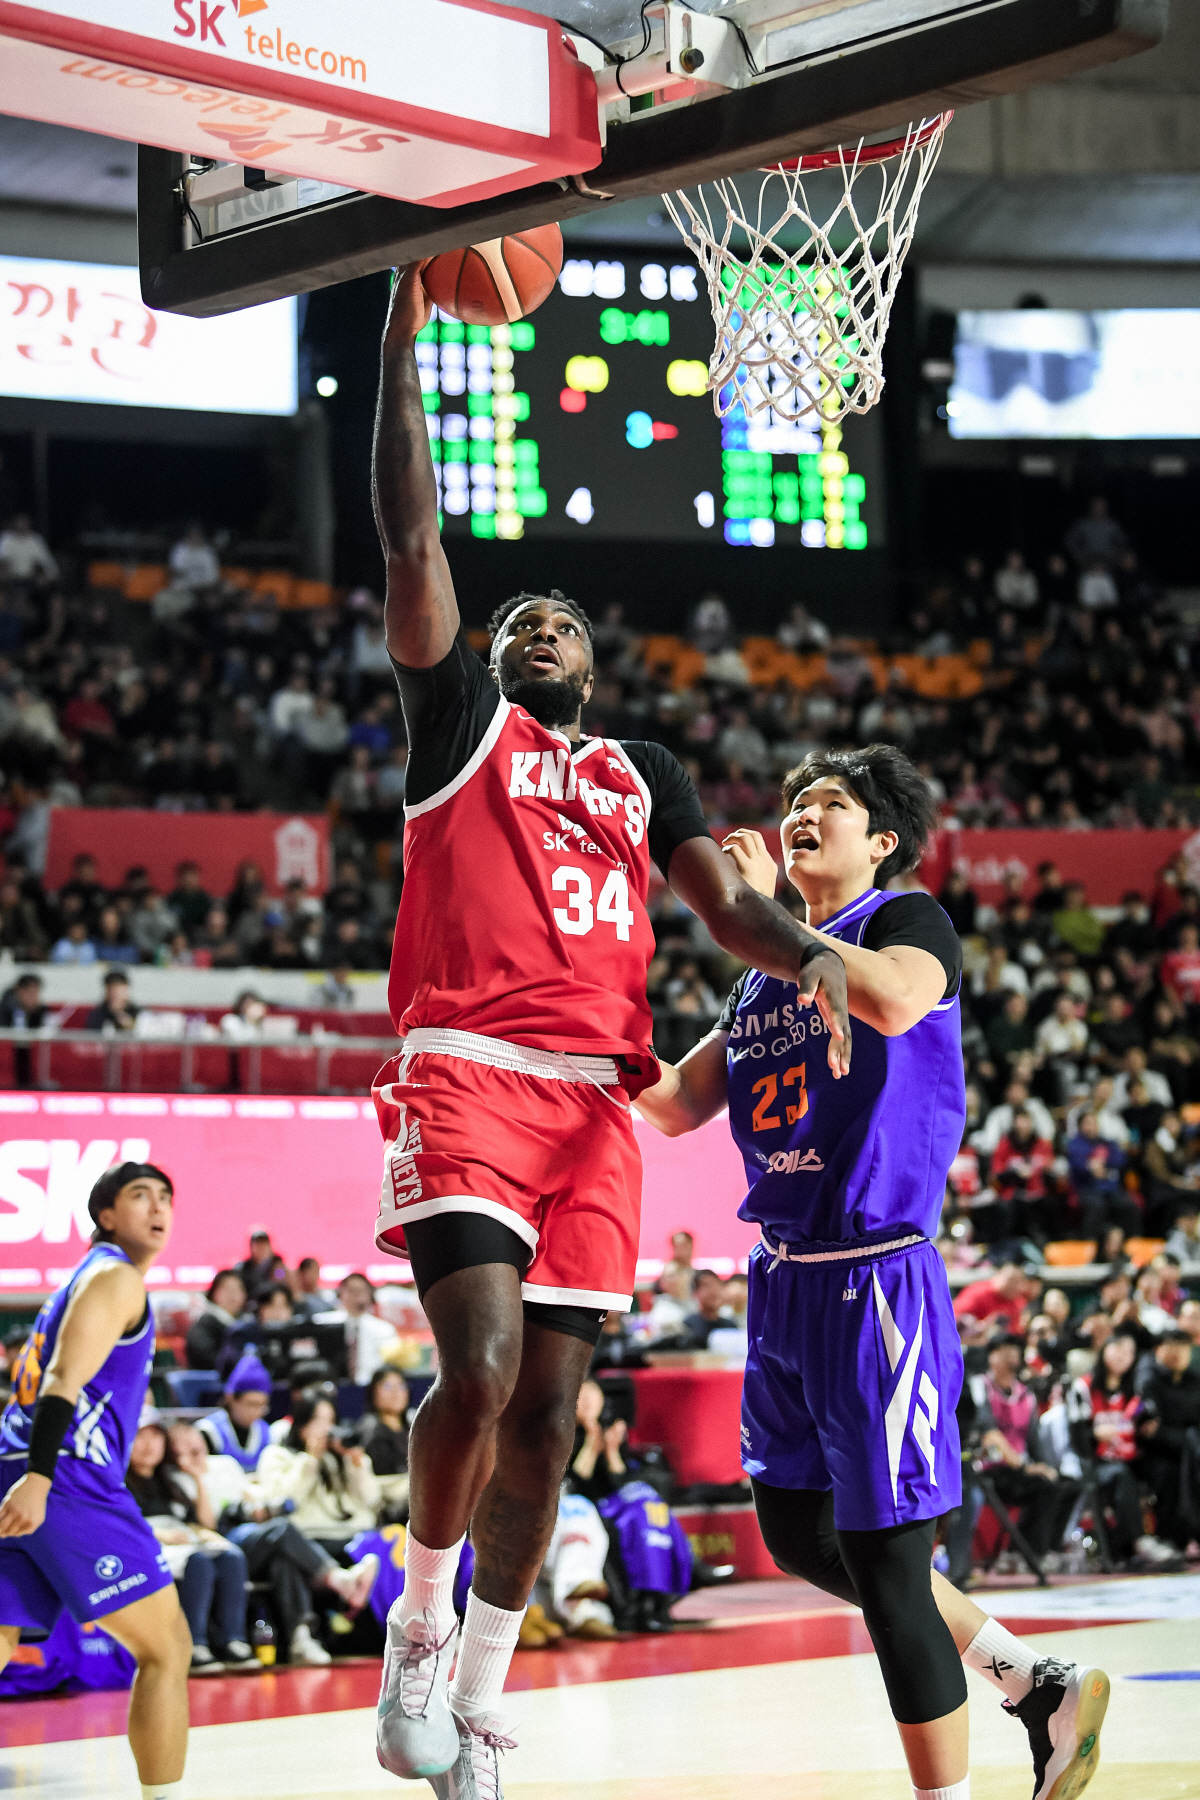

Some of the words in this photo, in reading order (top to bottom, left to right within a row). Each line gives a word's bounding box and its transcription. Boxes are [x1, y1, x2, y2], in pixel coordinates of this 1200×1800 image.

[173, 0, 227, 47] SK
[244, 25, 368, 82] telecom
[60, 59, 292, 122] telecom
[286, 119, 412, 153] SK
[542, 831, 571, 852] SK
[551, 865, 634, 942] 34
[752, 1062, 809, 1132] 23
